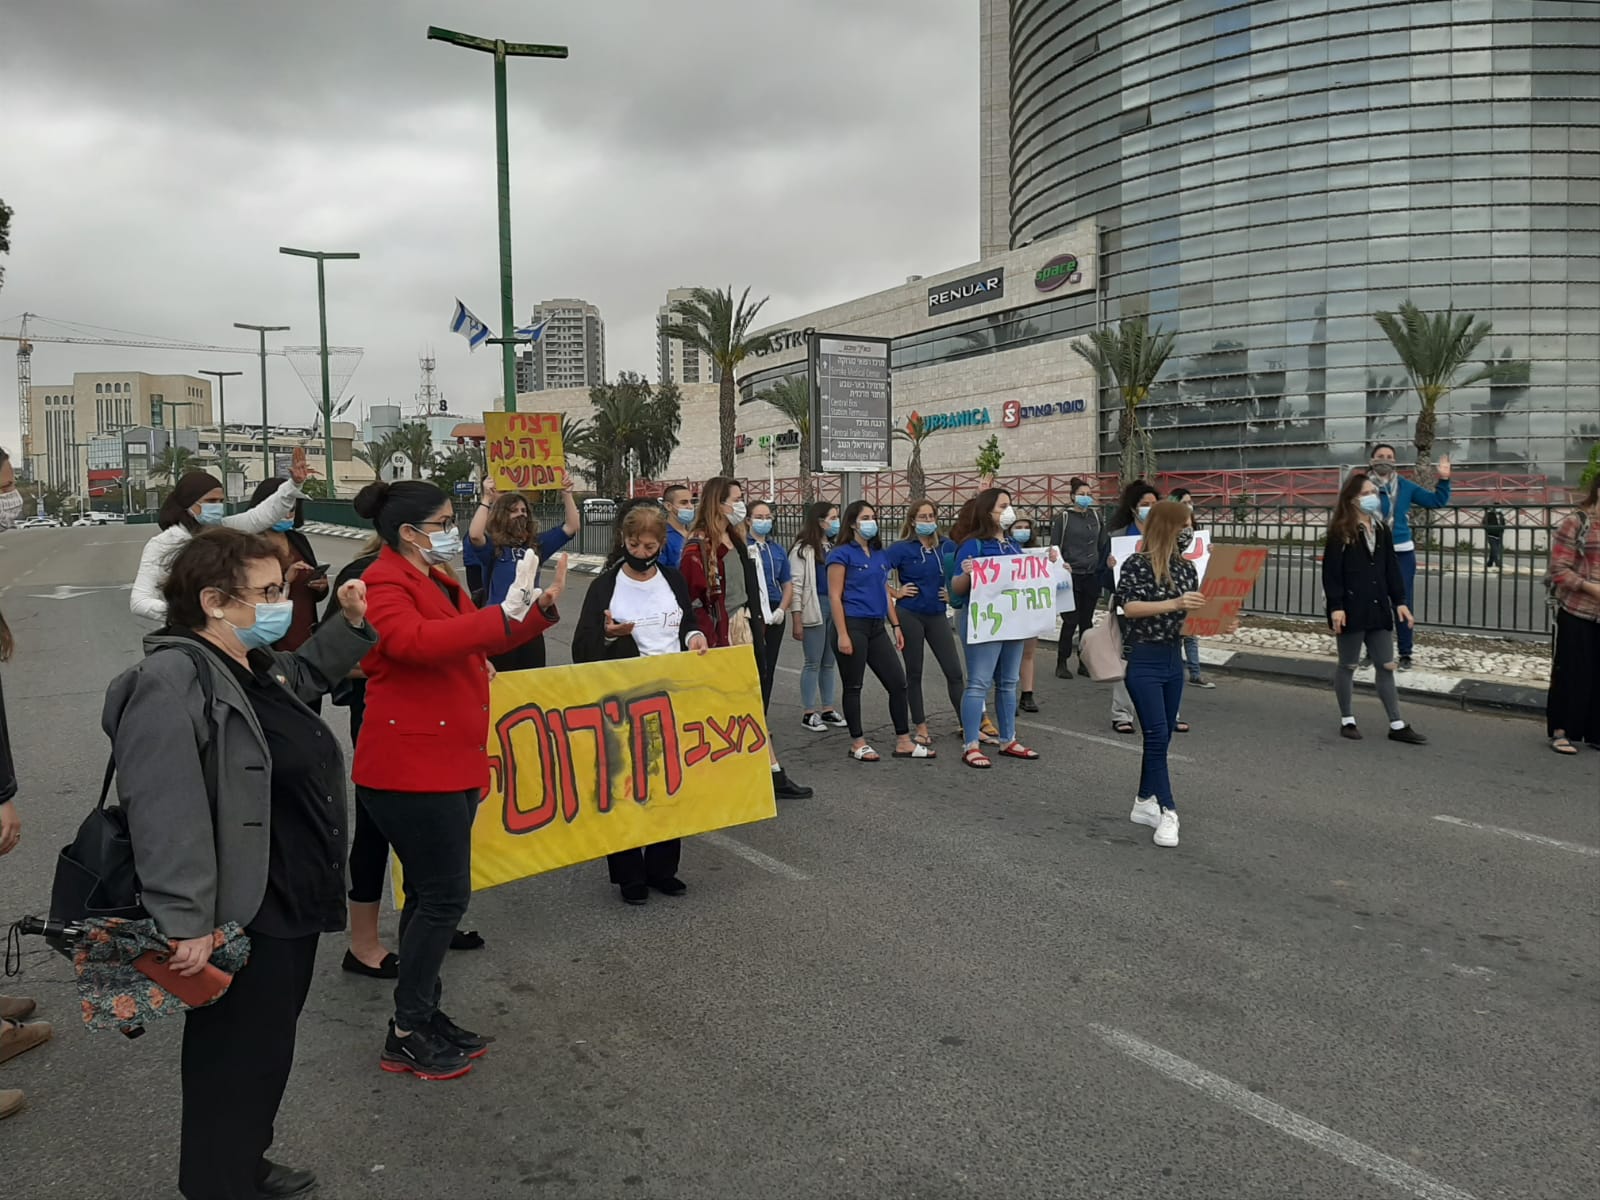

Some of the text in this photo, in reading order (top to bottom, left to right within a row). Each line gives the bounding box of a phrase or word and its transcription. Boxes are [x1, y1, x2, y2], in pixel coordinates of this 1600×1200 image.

[1035, 260, 1077, 282] space
[929, 277, 999, 308] RENUAR
[440, 400, 447, 411] 8
[508, 414, 558, 435] רצח
[923, 407, 990, 432] URBANICA
[490, 436, 552, 462] זה לא
[971, 556, 1050, 590] אתה לא
[1001, 586, 1052, 612] תגיד
[970, 602, 1003, 640] לי!
[683, 713, 766, 767] מצב
[495, 690, 683, 836] חירום
